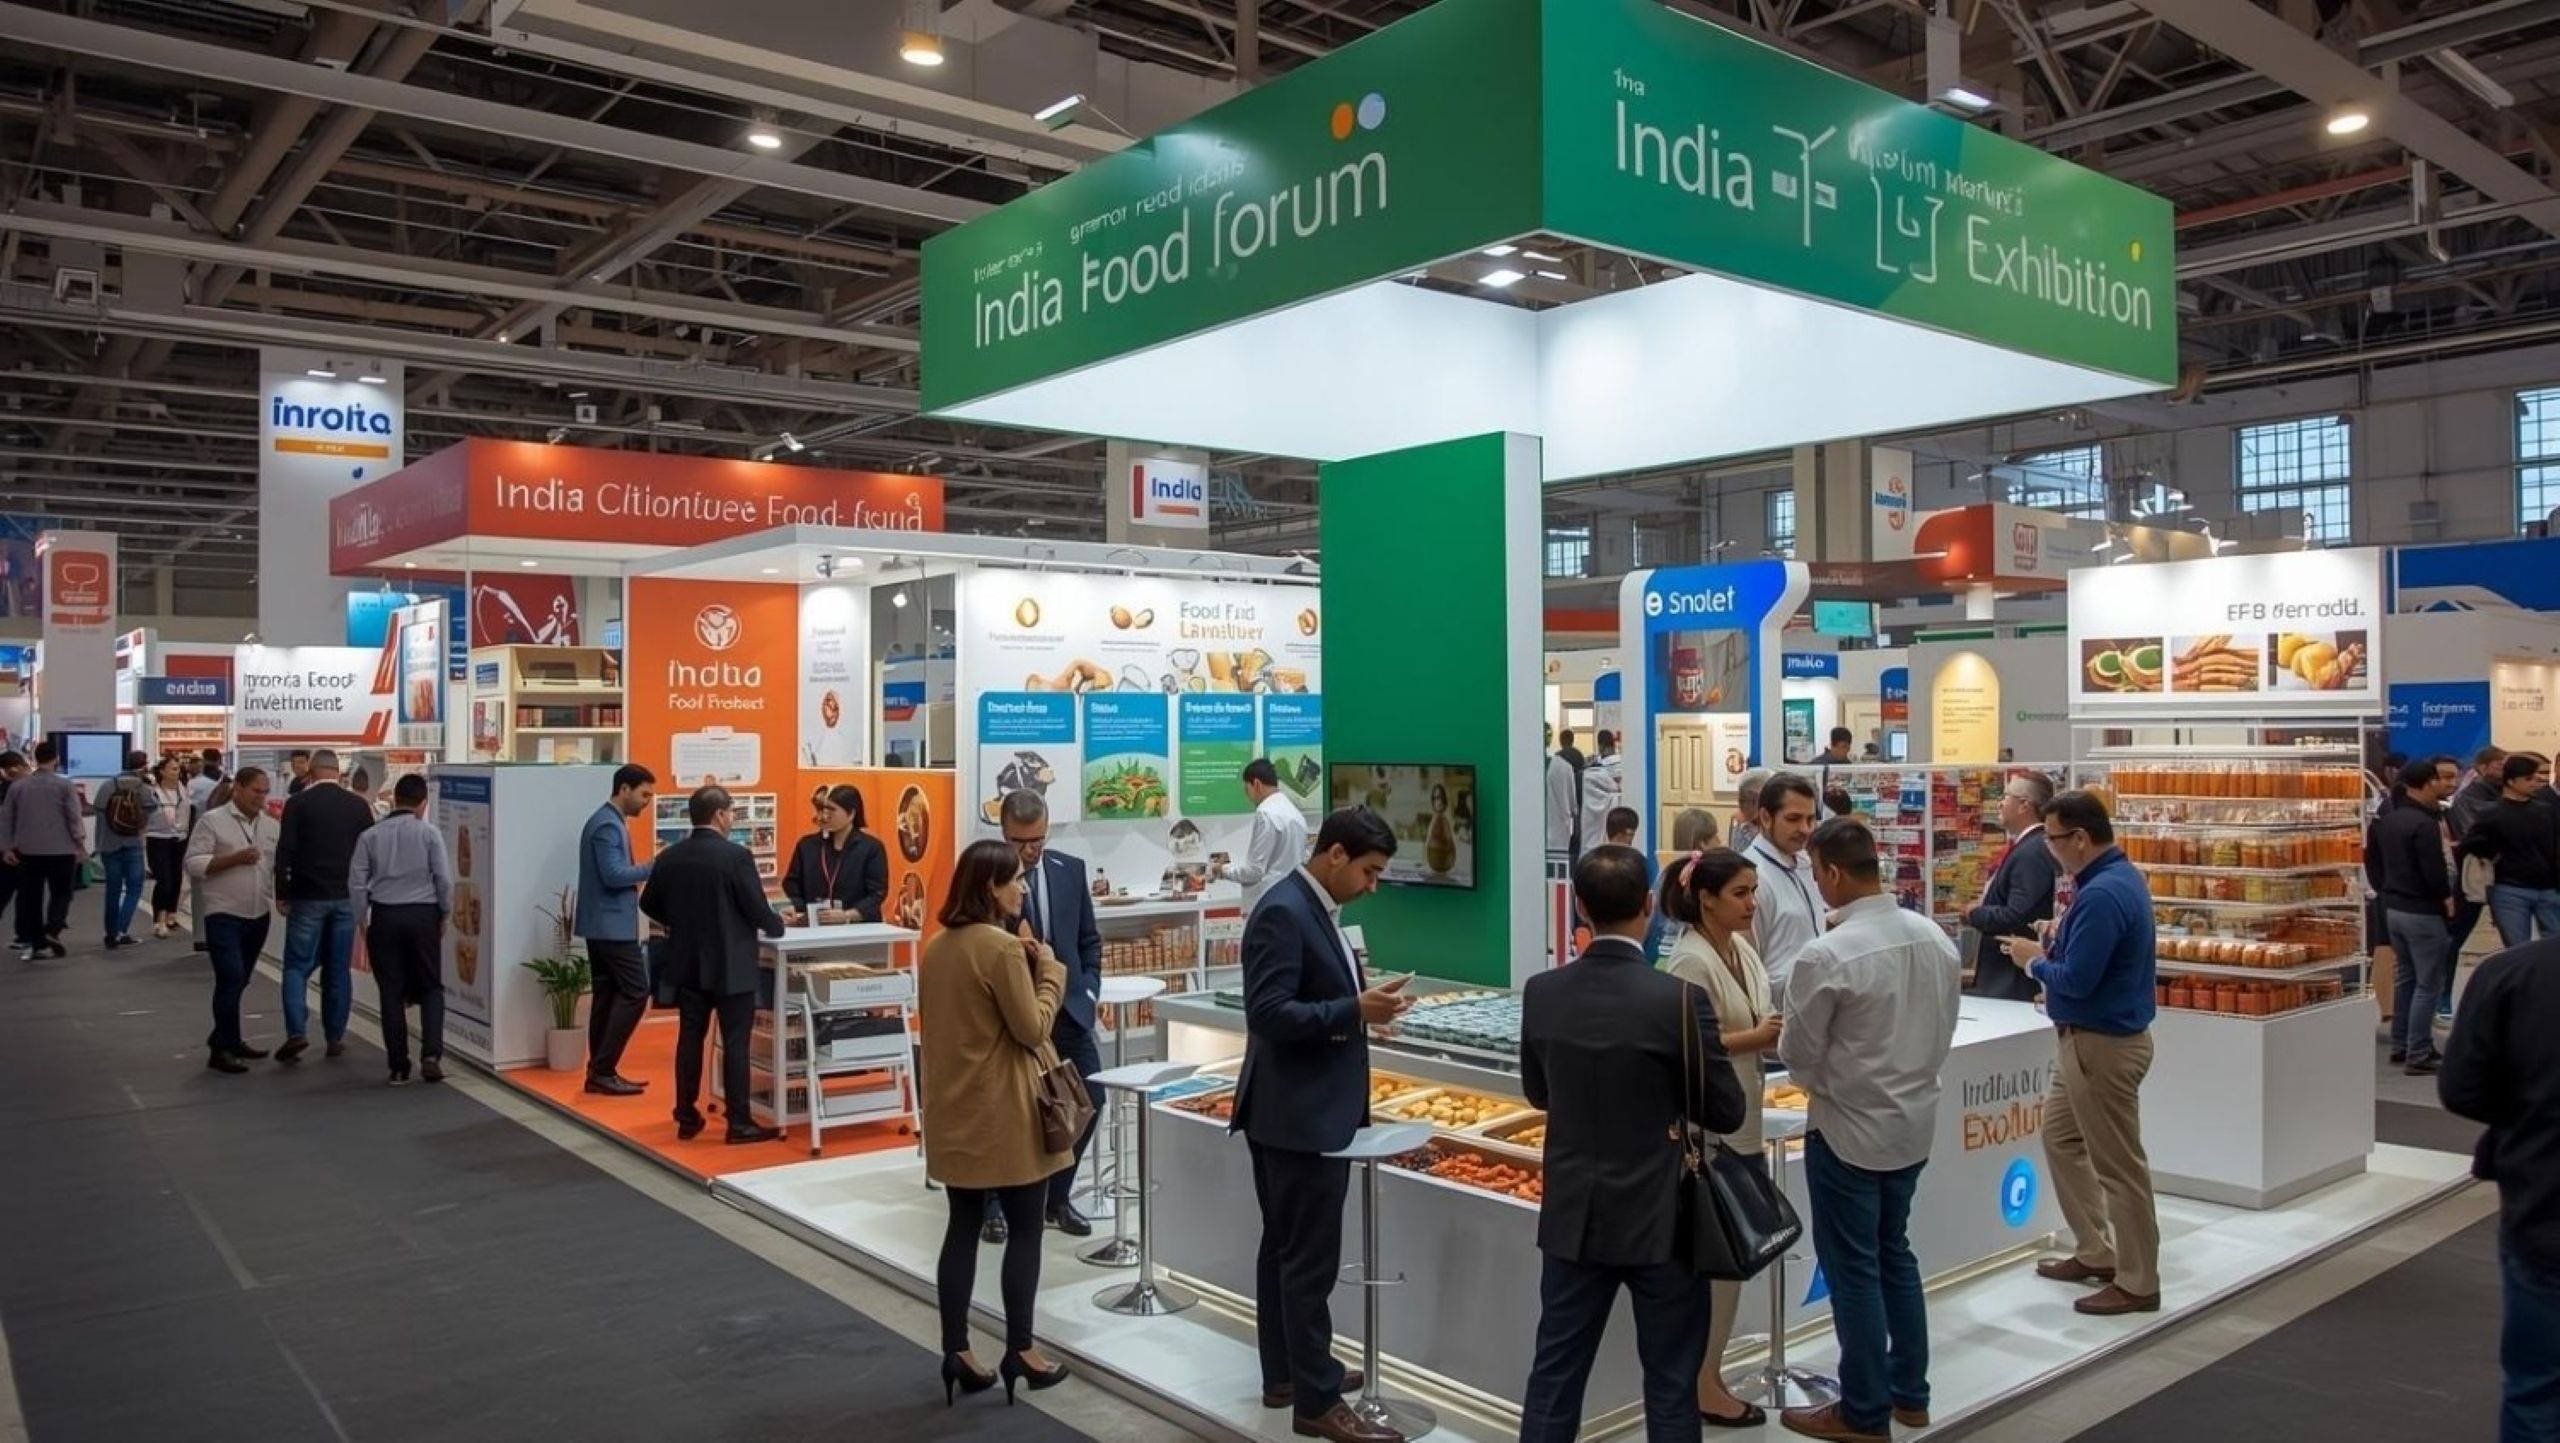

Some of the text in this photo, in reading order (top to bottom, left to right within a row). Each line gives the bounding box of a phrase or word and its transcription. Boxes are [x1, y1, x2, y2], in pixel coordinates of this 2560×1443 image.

[975, 273, 1063, 349] India
[1082, 207, 1190, 313] Food
[1616, 100, 2152, 331] India Exhibition
[496, 474, 584, 513] India
